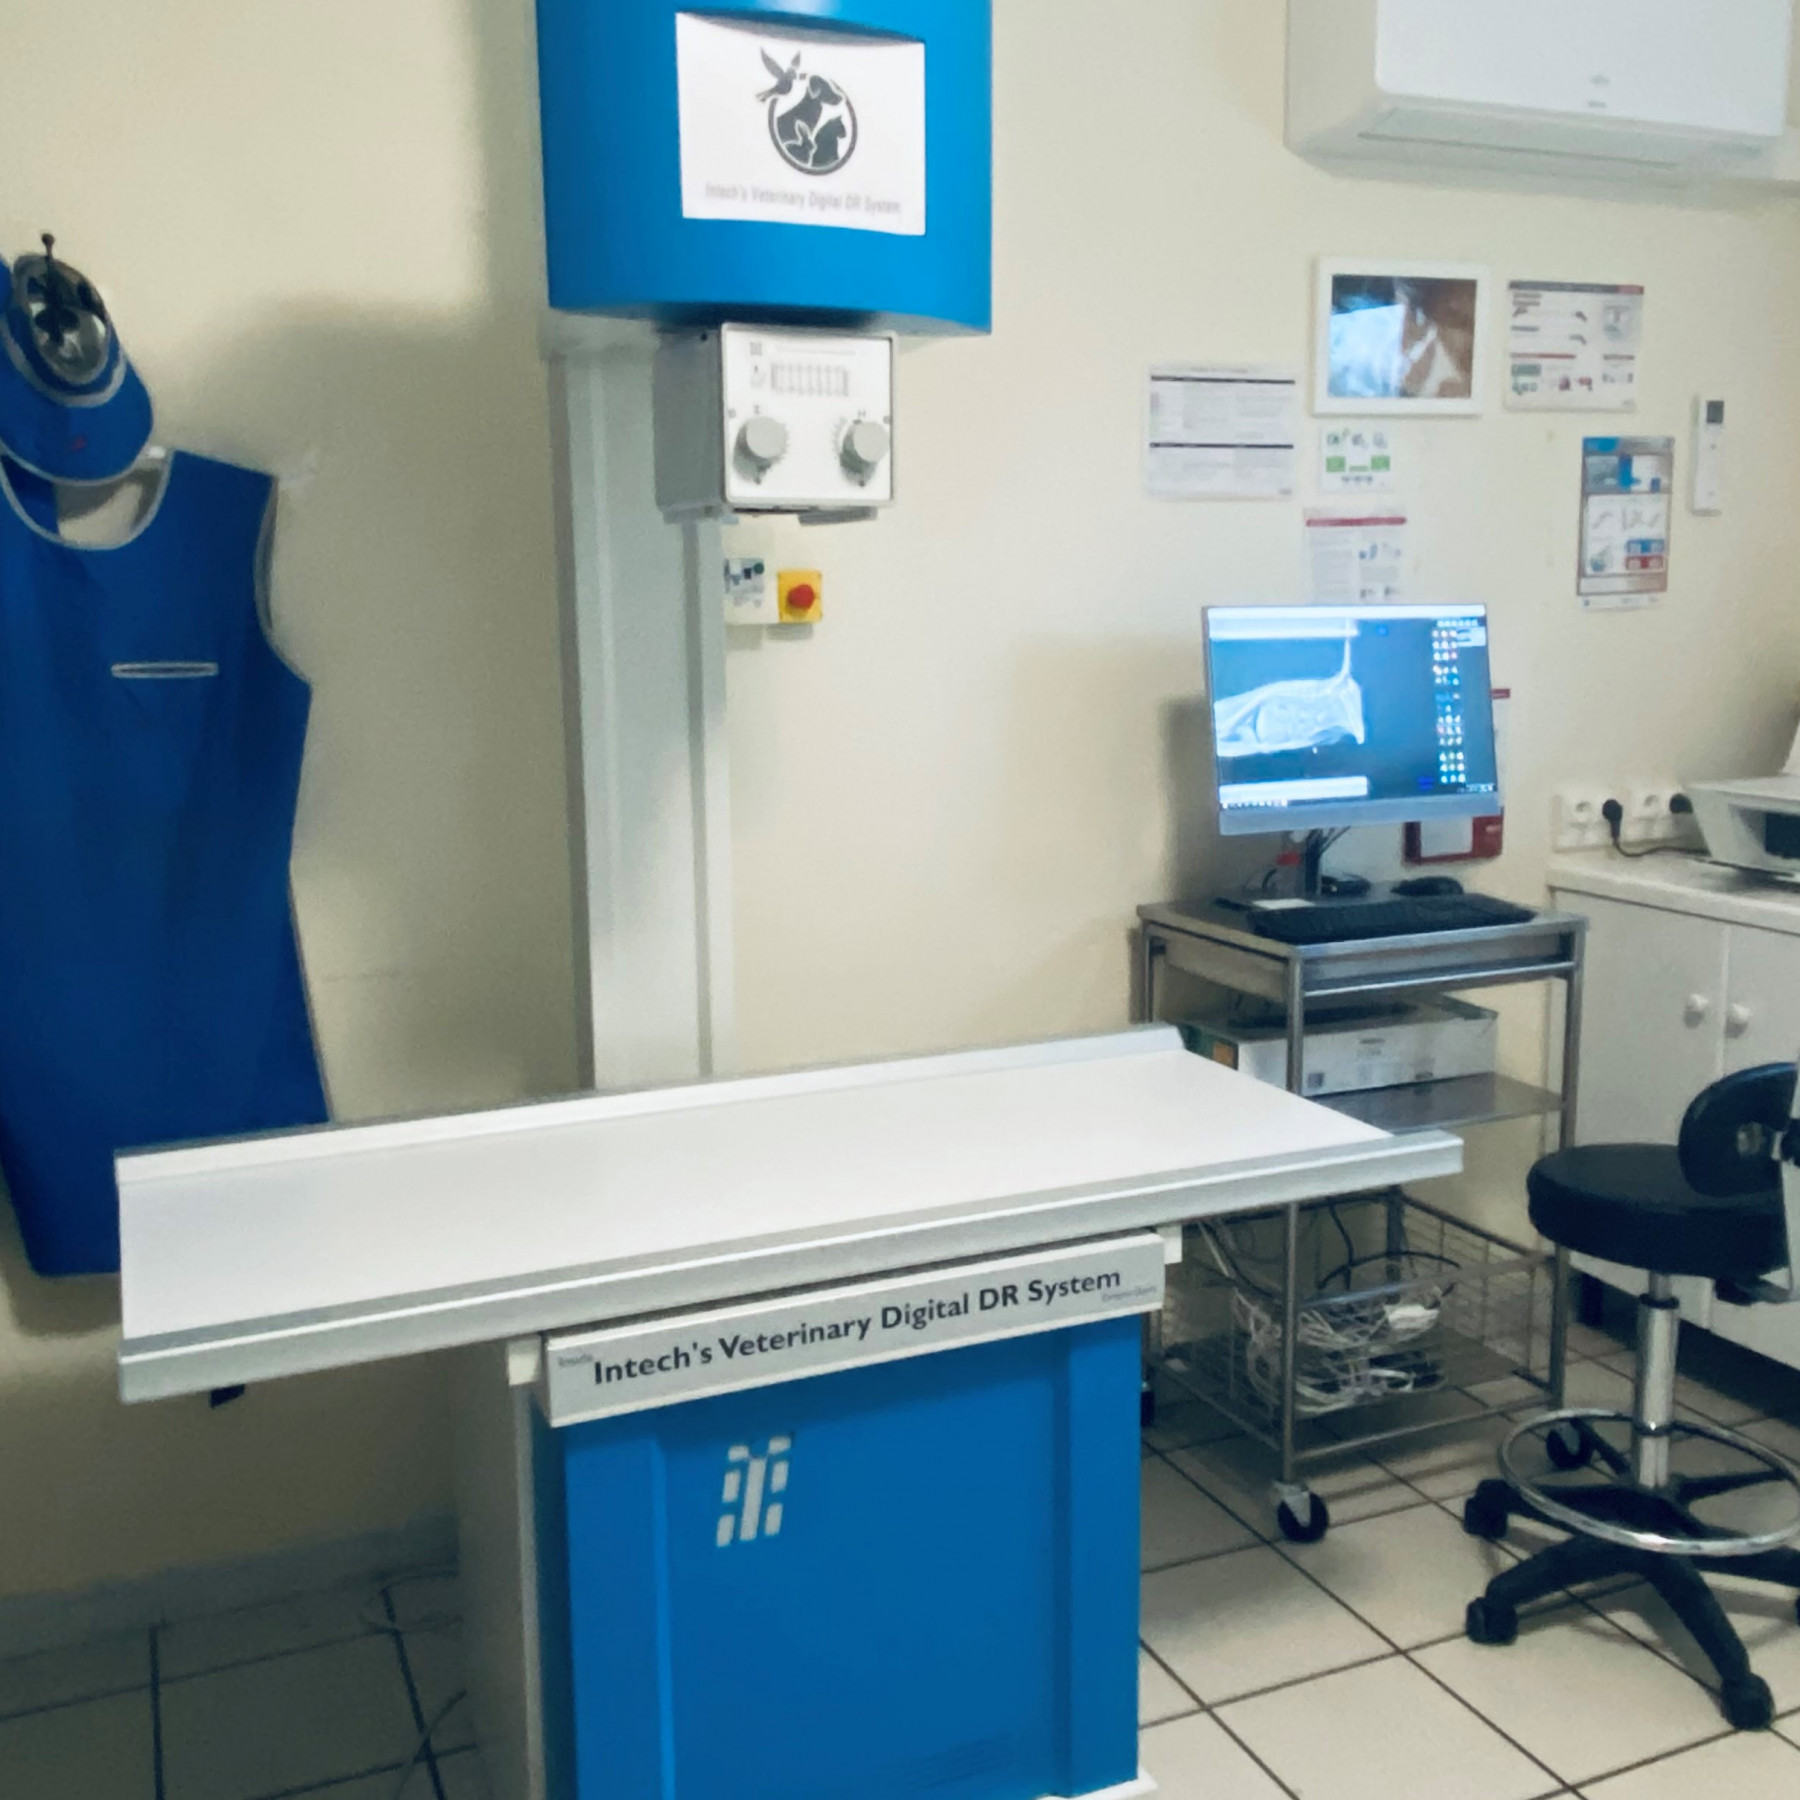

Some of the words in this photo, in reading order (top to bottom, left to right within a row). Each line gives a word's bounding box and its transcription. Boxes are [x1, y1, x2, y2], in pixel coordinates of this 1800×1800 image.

[594, 1343, 713, 1385] Intech's
[718, 1317, 872, 1359] Veterinary
[881, 1292, 969, 1330] Digital
[979, 1284, 1019, 1312] DR
[1028, 1271, 1121, 1305] System
